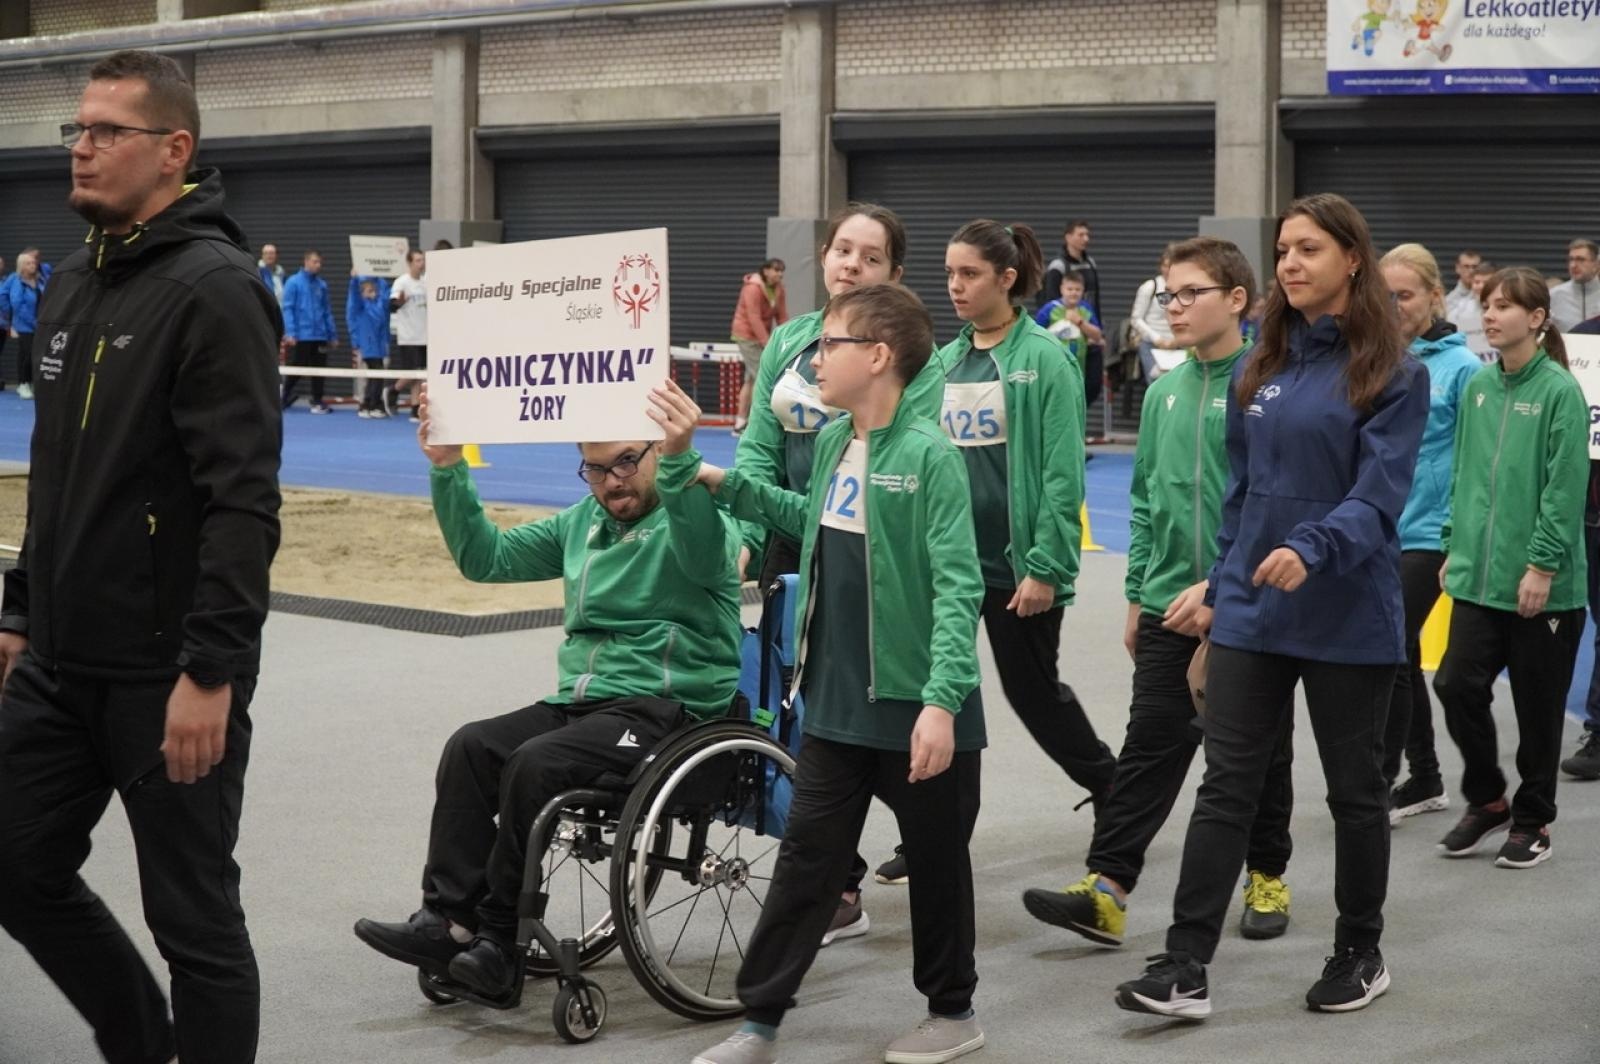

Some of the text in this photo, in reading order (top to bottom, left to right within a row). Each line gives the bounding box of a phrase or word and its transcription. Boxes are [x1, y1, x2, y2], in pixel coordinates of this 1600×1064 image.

[1463, 23, 1546, 40] dla każdego!
[435, 282, 513, 303] Olimpiady
[521, 275, 602, 298] Specjalne
[565, 302, 603, 323] Śląskie
[112, 334, 134, 349] 4F
[440, 348, 655, 389] “KONICZYNKA”
[519, 388, 566, 421] ŻORY
[944, 408, 1000, 440] 125
